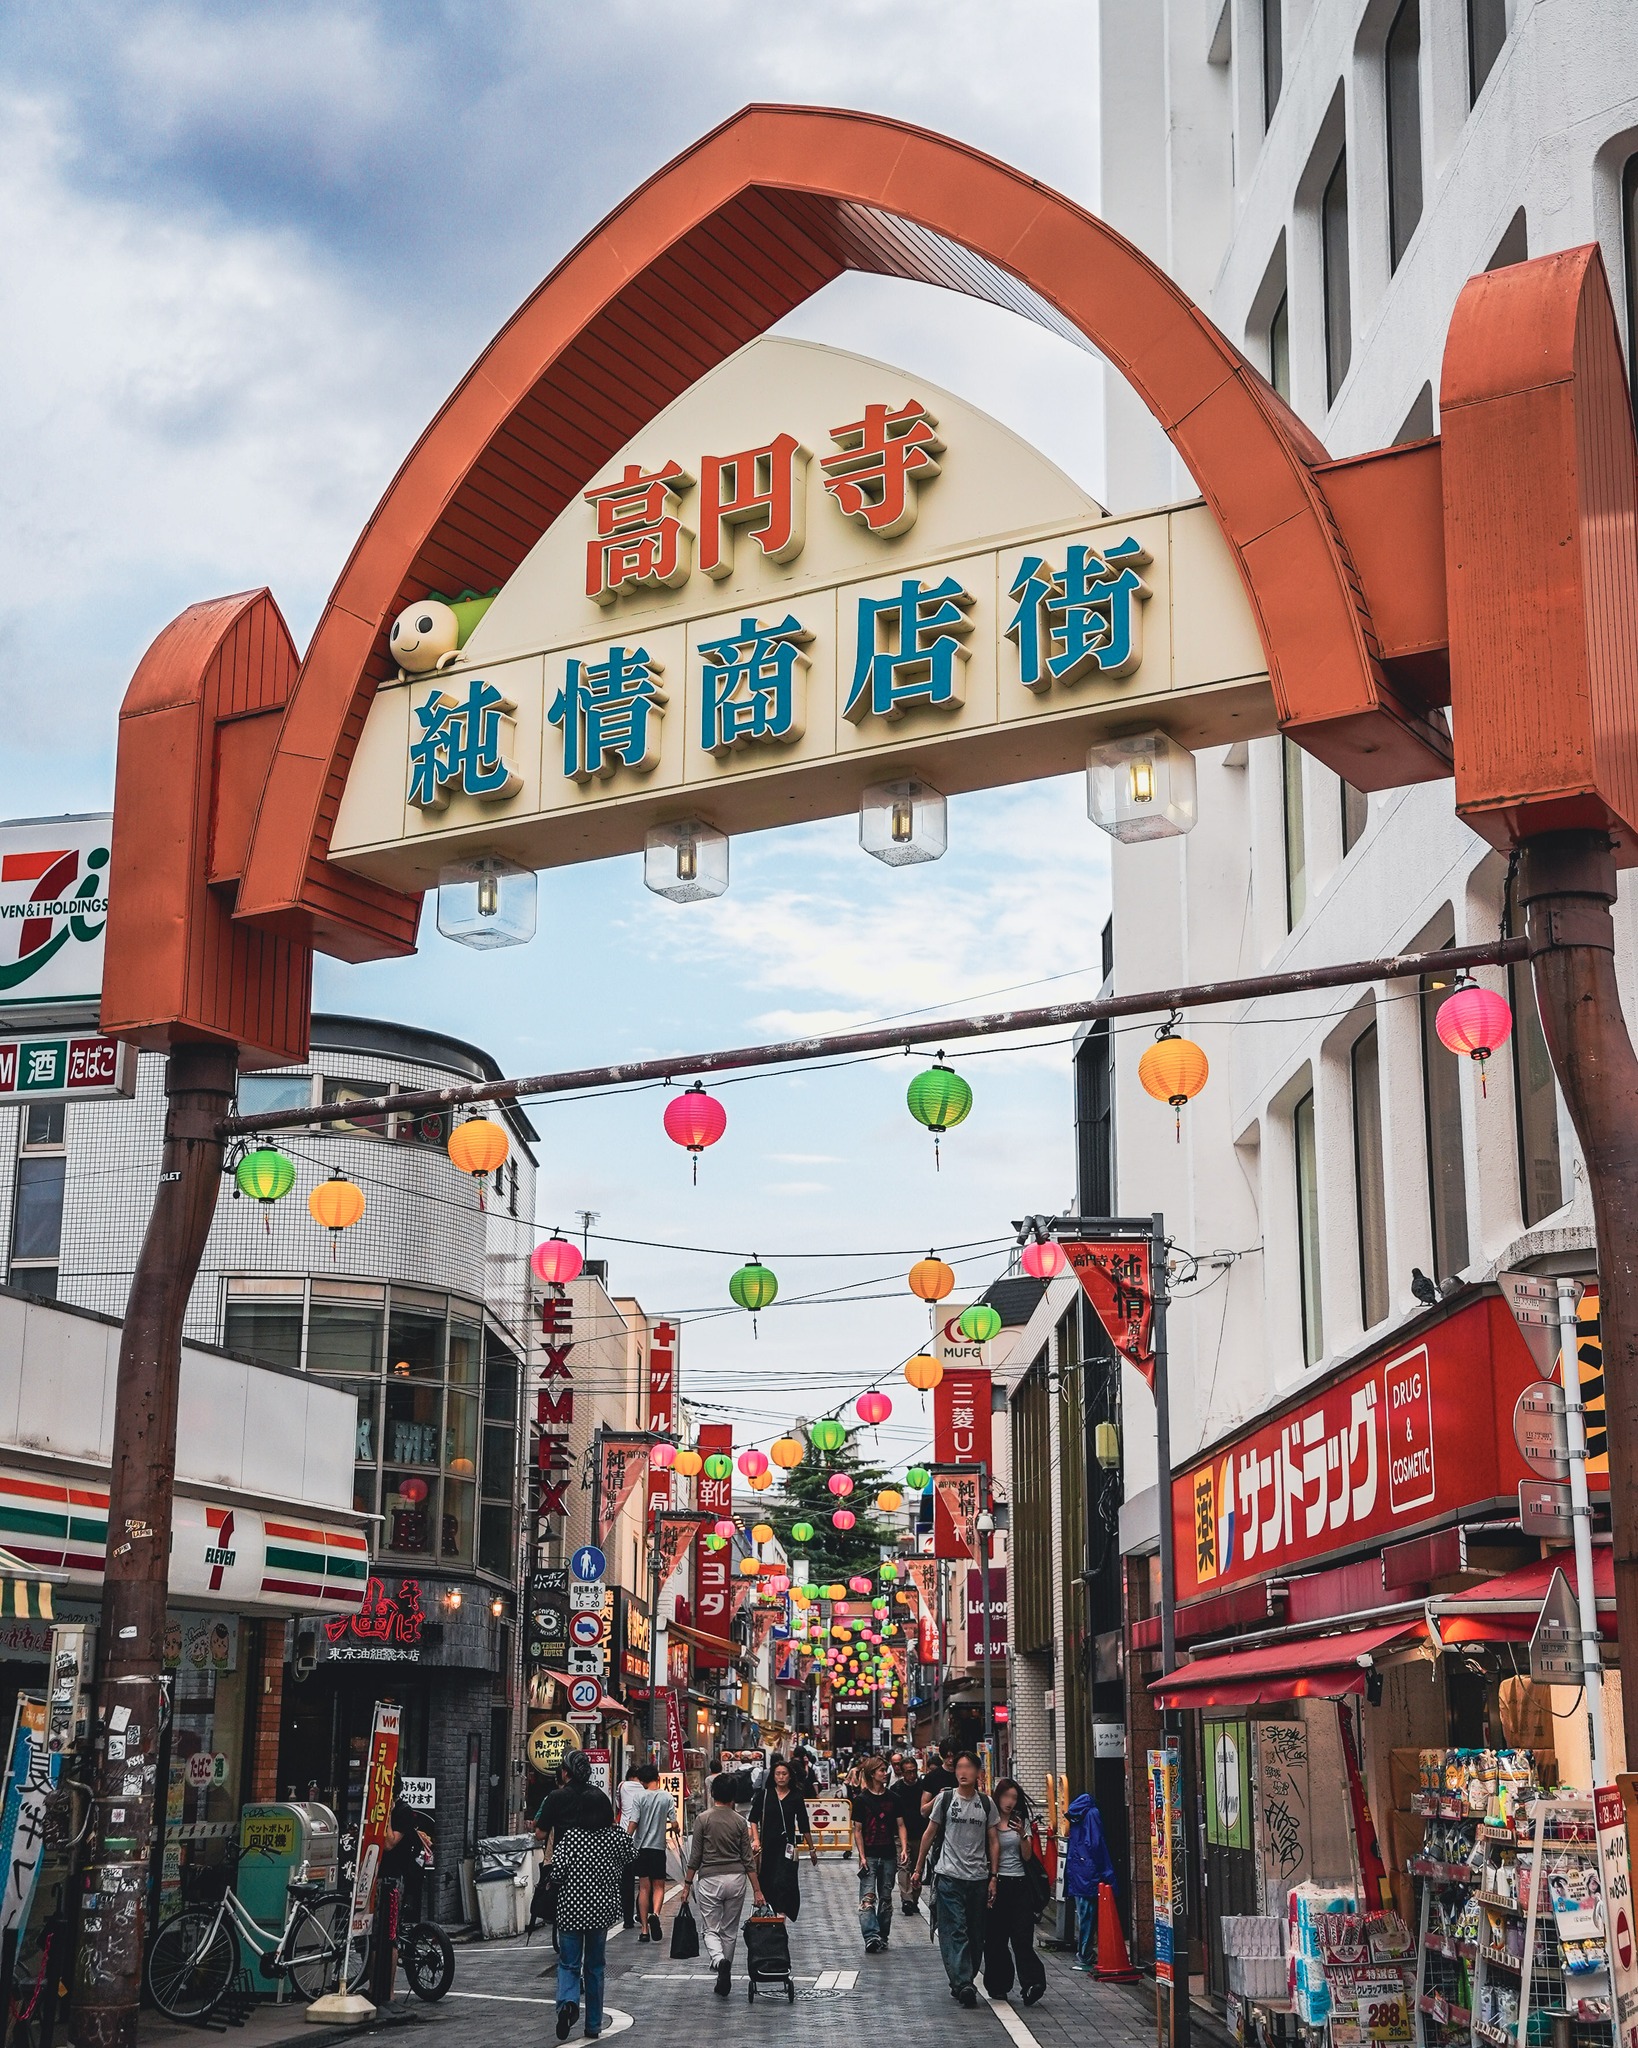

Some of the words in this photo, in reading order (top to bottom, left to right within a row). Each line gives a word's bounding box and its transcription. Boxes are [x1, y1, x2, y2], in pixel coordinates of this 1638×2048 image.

[583, 397, 940, 600] 高円寺
[406, 536, 1150, 808] 純情商店街
[43, 898, 109, 916] HOLDINGS
[27, 1050, 58, 1084] 酒
[70, 1047, 114, 1080] たばこ
[944, 1347, 981, 1358] MUFG
[537, 1285, 574, 1517] EXMEX
[1393, 1373, 1421, 1409] DRUG
[649, 1373, 670, 1512] ツル局
[1406, 1417, 1413, 1442] &
[1238, 1379, 1378, 1561] サンドラッグ
[1392, 1447, 1430, 1485] COSMETIC
[605, 1449, 626, 1521] 純情商店街
[700, 1480, 730, 1506] 靴
[1195, 1478, 1215, 1574] 薬
[205, 1508, 235, 1590] 7
[573, 1586, 603, 1594] 自転車を除く
[327, 1647, 420, 1662] 東京油組総本店
[575, 1686, 595, 1702] 20
[190, 1757, 211, 1777] たばこ
[214, 1757, 224, 1777] 酒
[246, 1823, 292, 1834] ペットボトル
[250, 1834, 287, 1848] 回収機
[1366, 1968, 1399, 1980] 特選品
